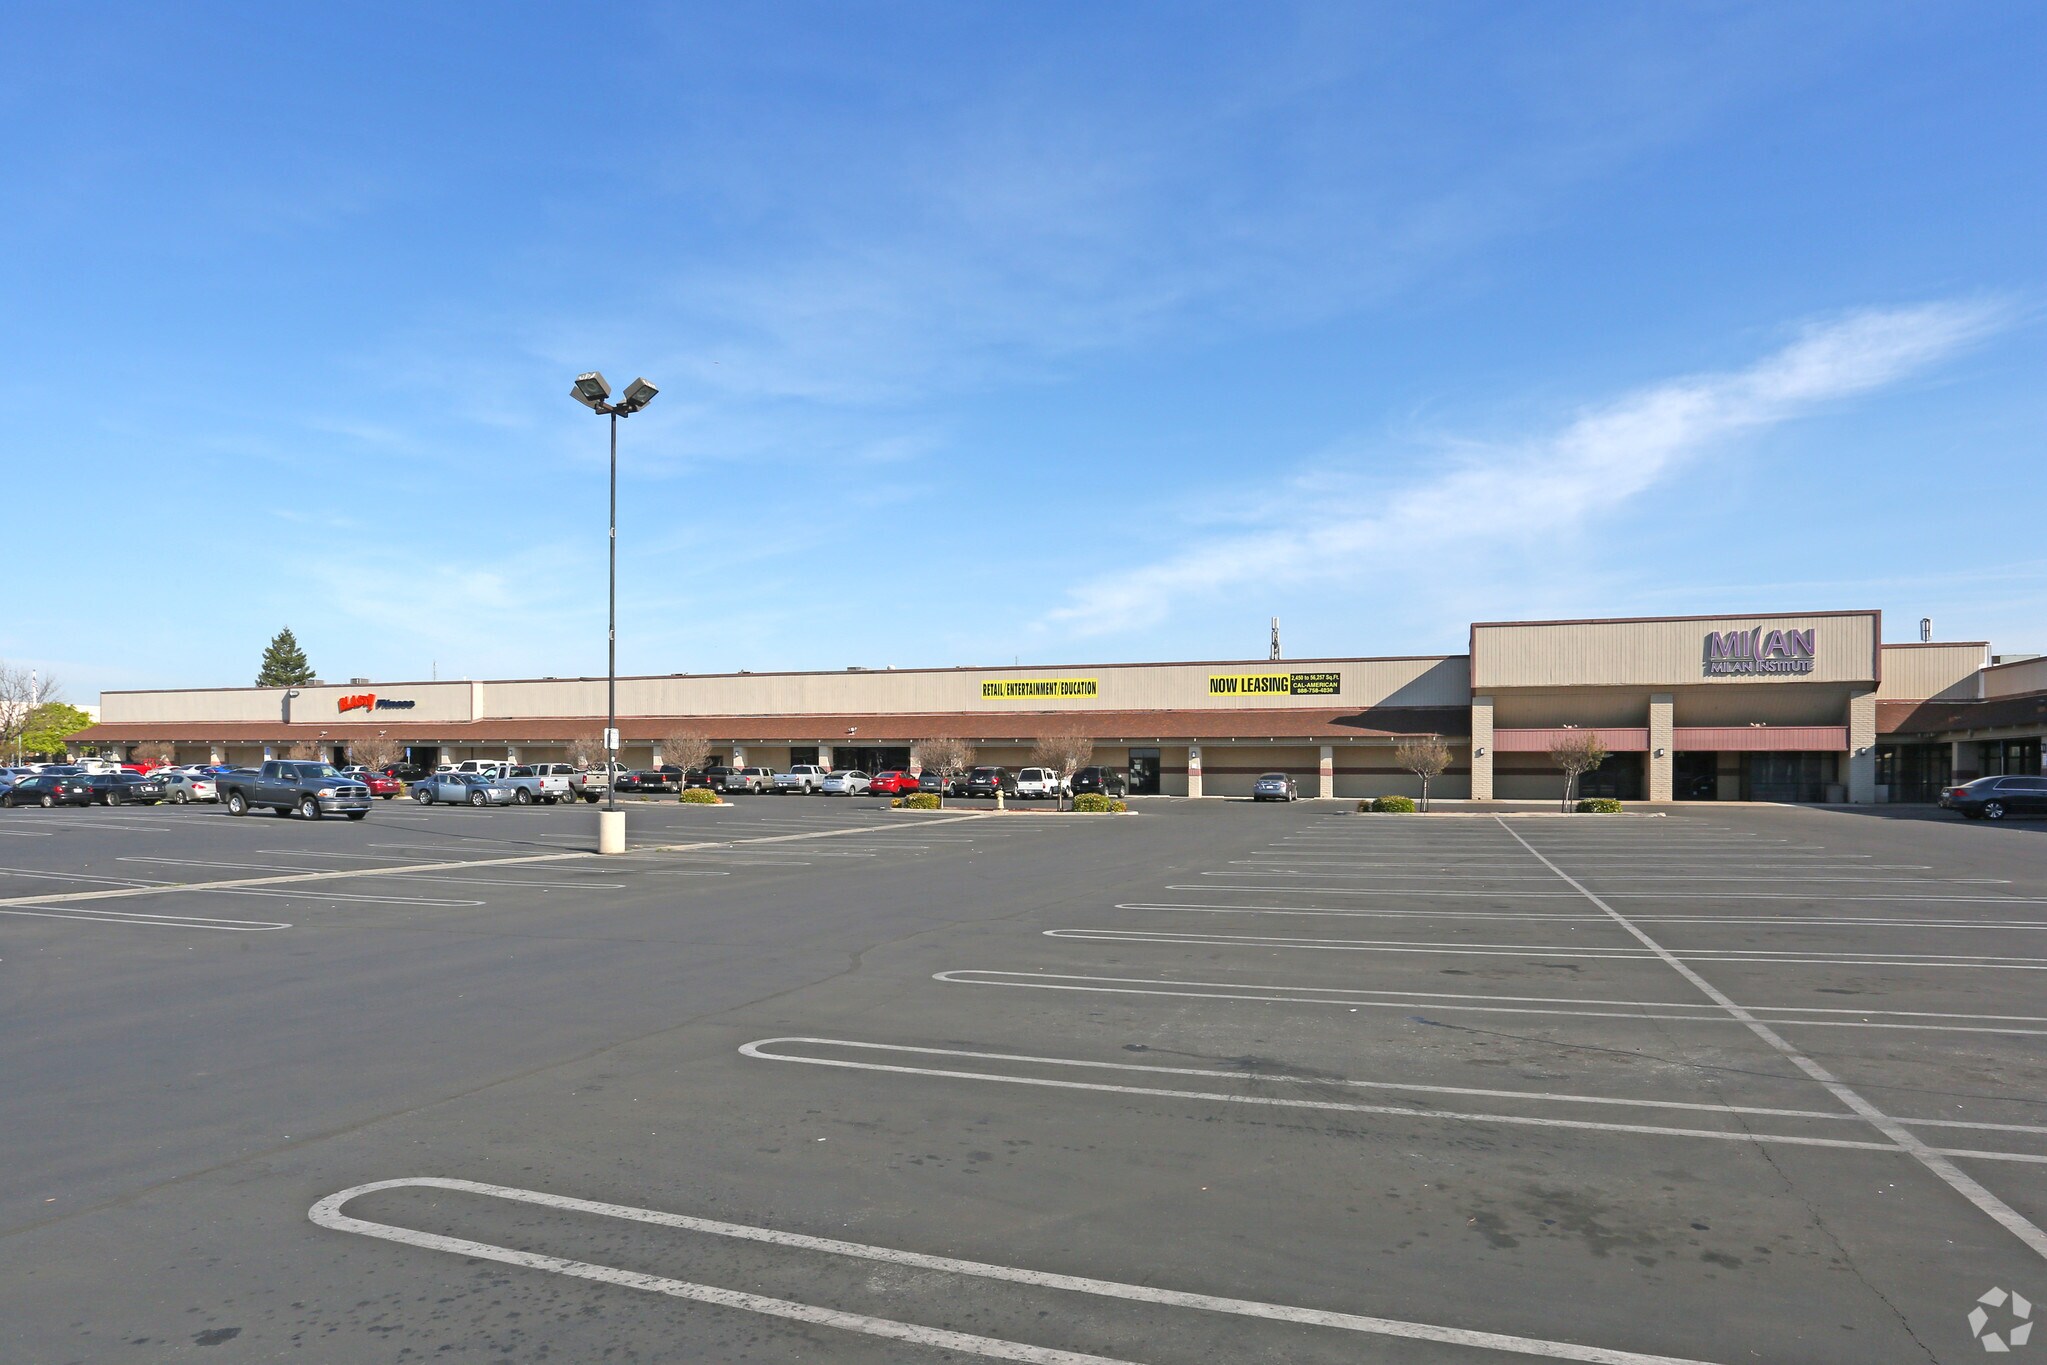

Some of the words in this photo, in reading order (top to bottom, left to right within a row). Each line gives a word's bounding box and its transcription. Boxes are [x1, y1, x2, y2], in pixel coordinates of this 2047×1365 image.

[1710, 624, 1815, 661] MILAN
[1711, 661, 1753, 673] MILAN
[1756, 660, 1815, 672] INSTITUTE
[1210, 678, 1238, 693] NOW
[1241, 676, 1289, 692] LEASING
